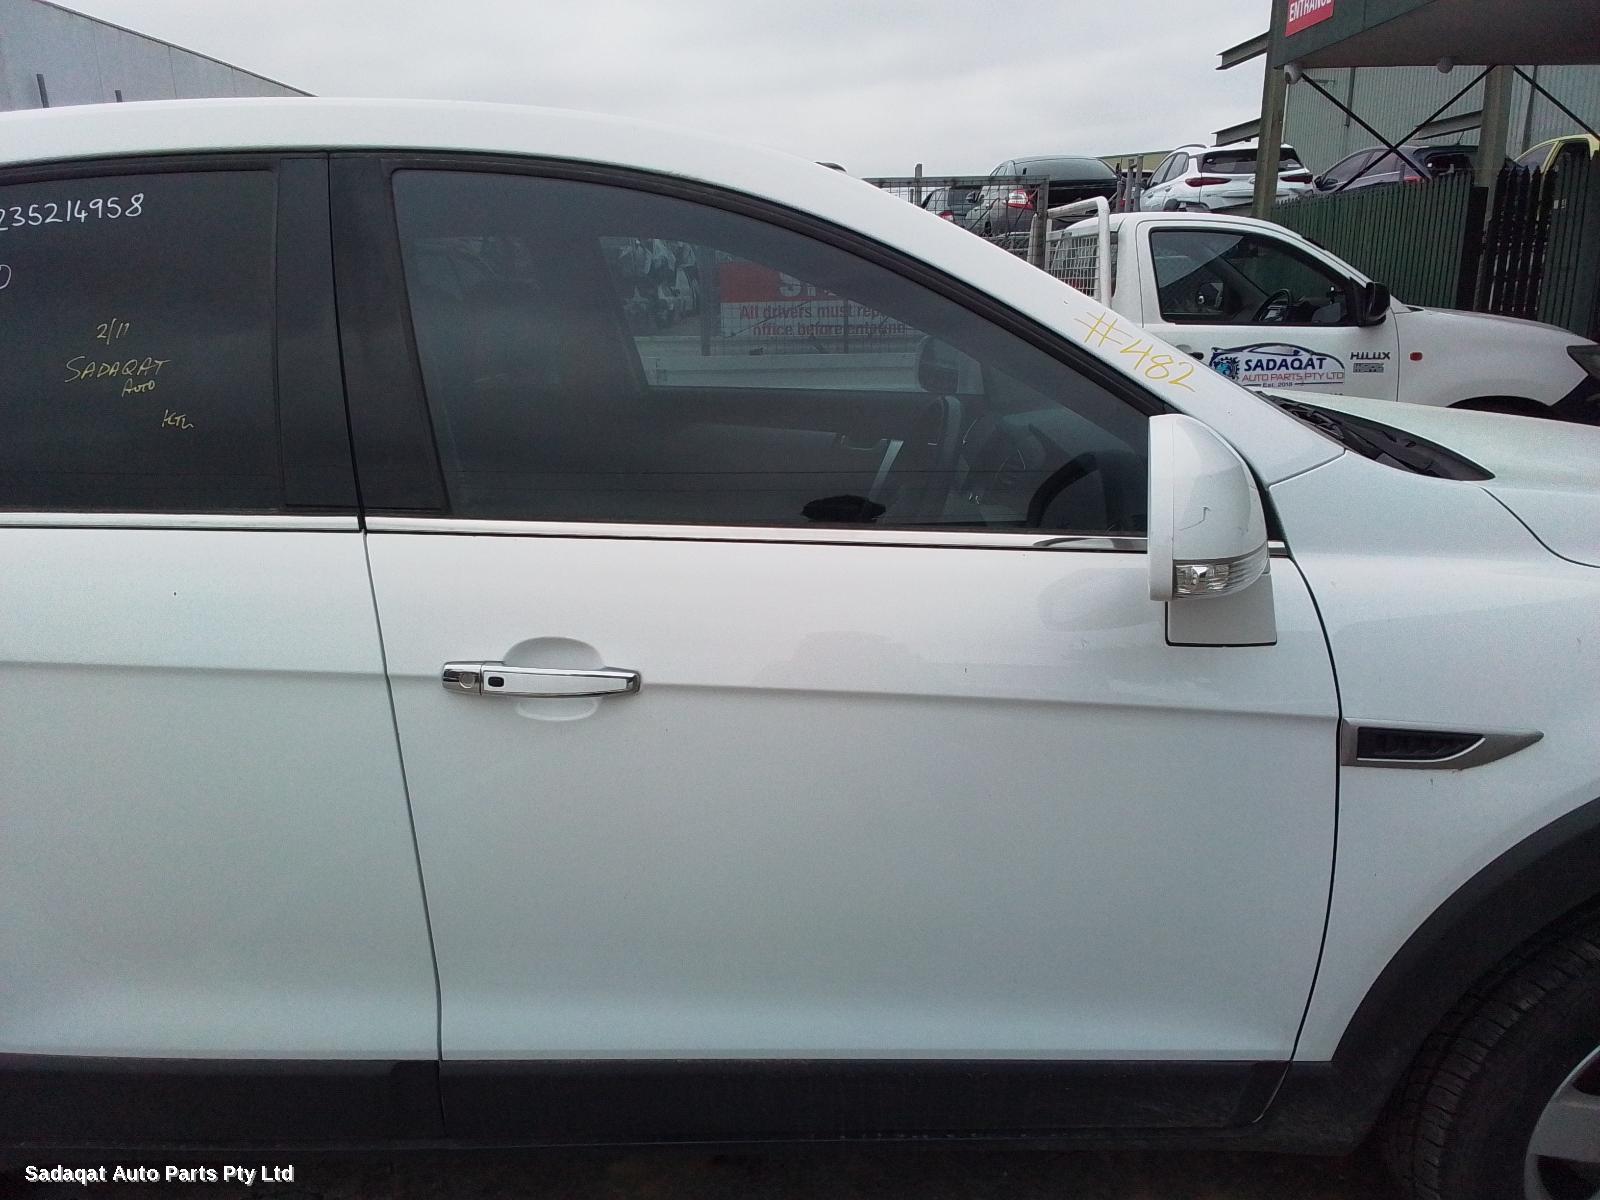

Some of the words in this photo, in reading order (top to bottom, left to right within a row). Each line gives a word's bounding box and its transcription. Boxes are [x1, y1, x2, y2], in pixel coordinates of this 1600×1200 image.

[1289, 0, 1331, 22] ENTRAN
[763, 303, 812, 318] drivers
[1074, 311, 1196, 393] #482
[1350, 351, 1391, 360] HILUX
[64, 356, 172, 383] SADAQAT
[1243, 357, 1327, 372] SADAQAT
[1242, 373, 1269, 382] AUTO
[1271, 373, 1303, 381] PARTS
[1304, 372, 1325, 380] PTY
[1326, 371, 1345, 380] LTD
